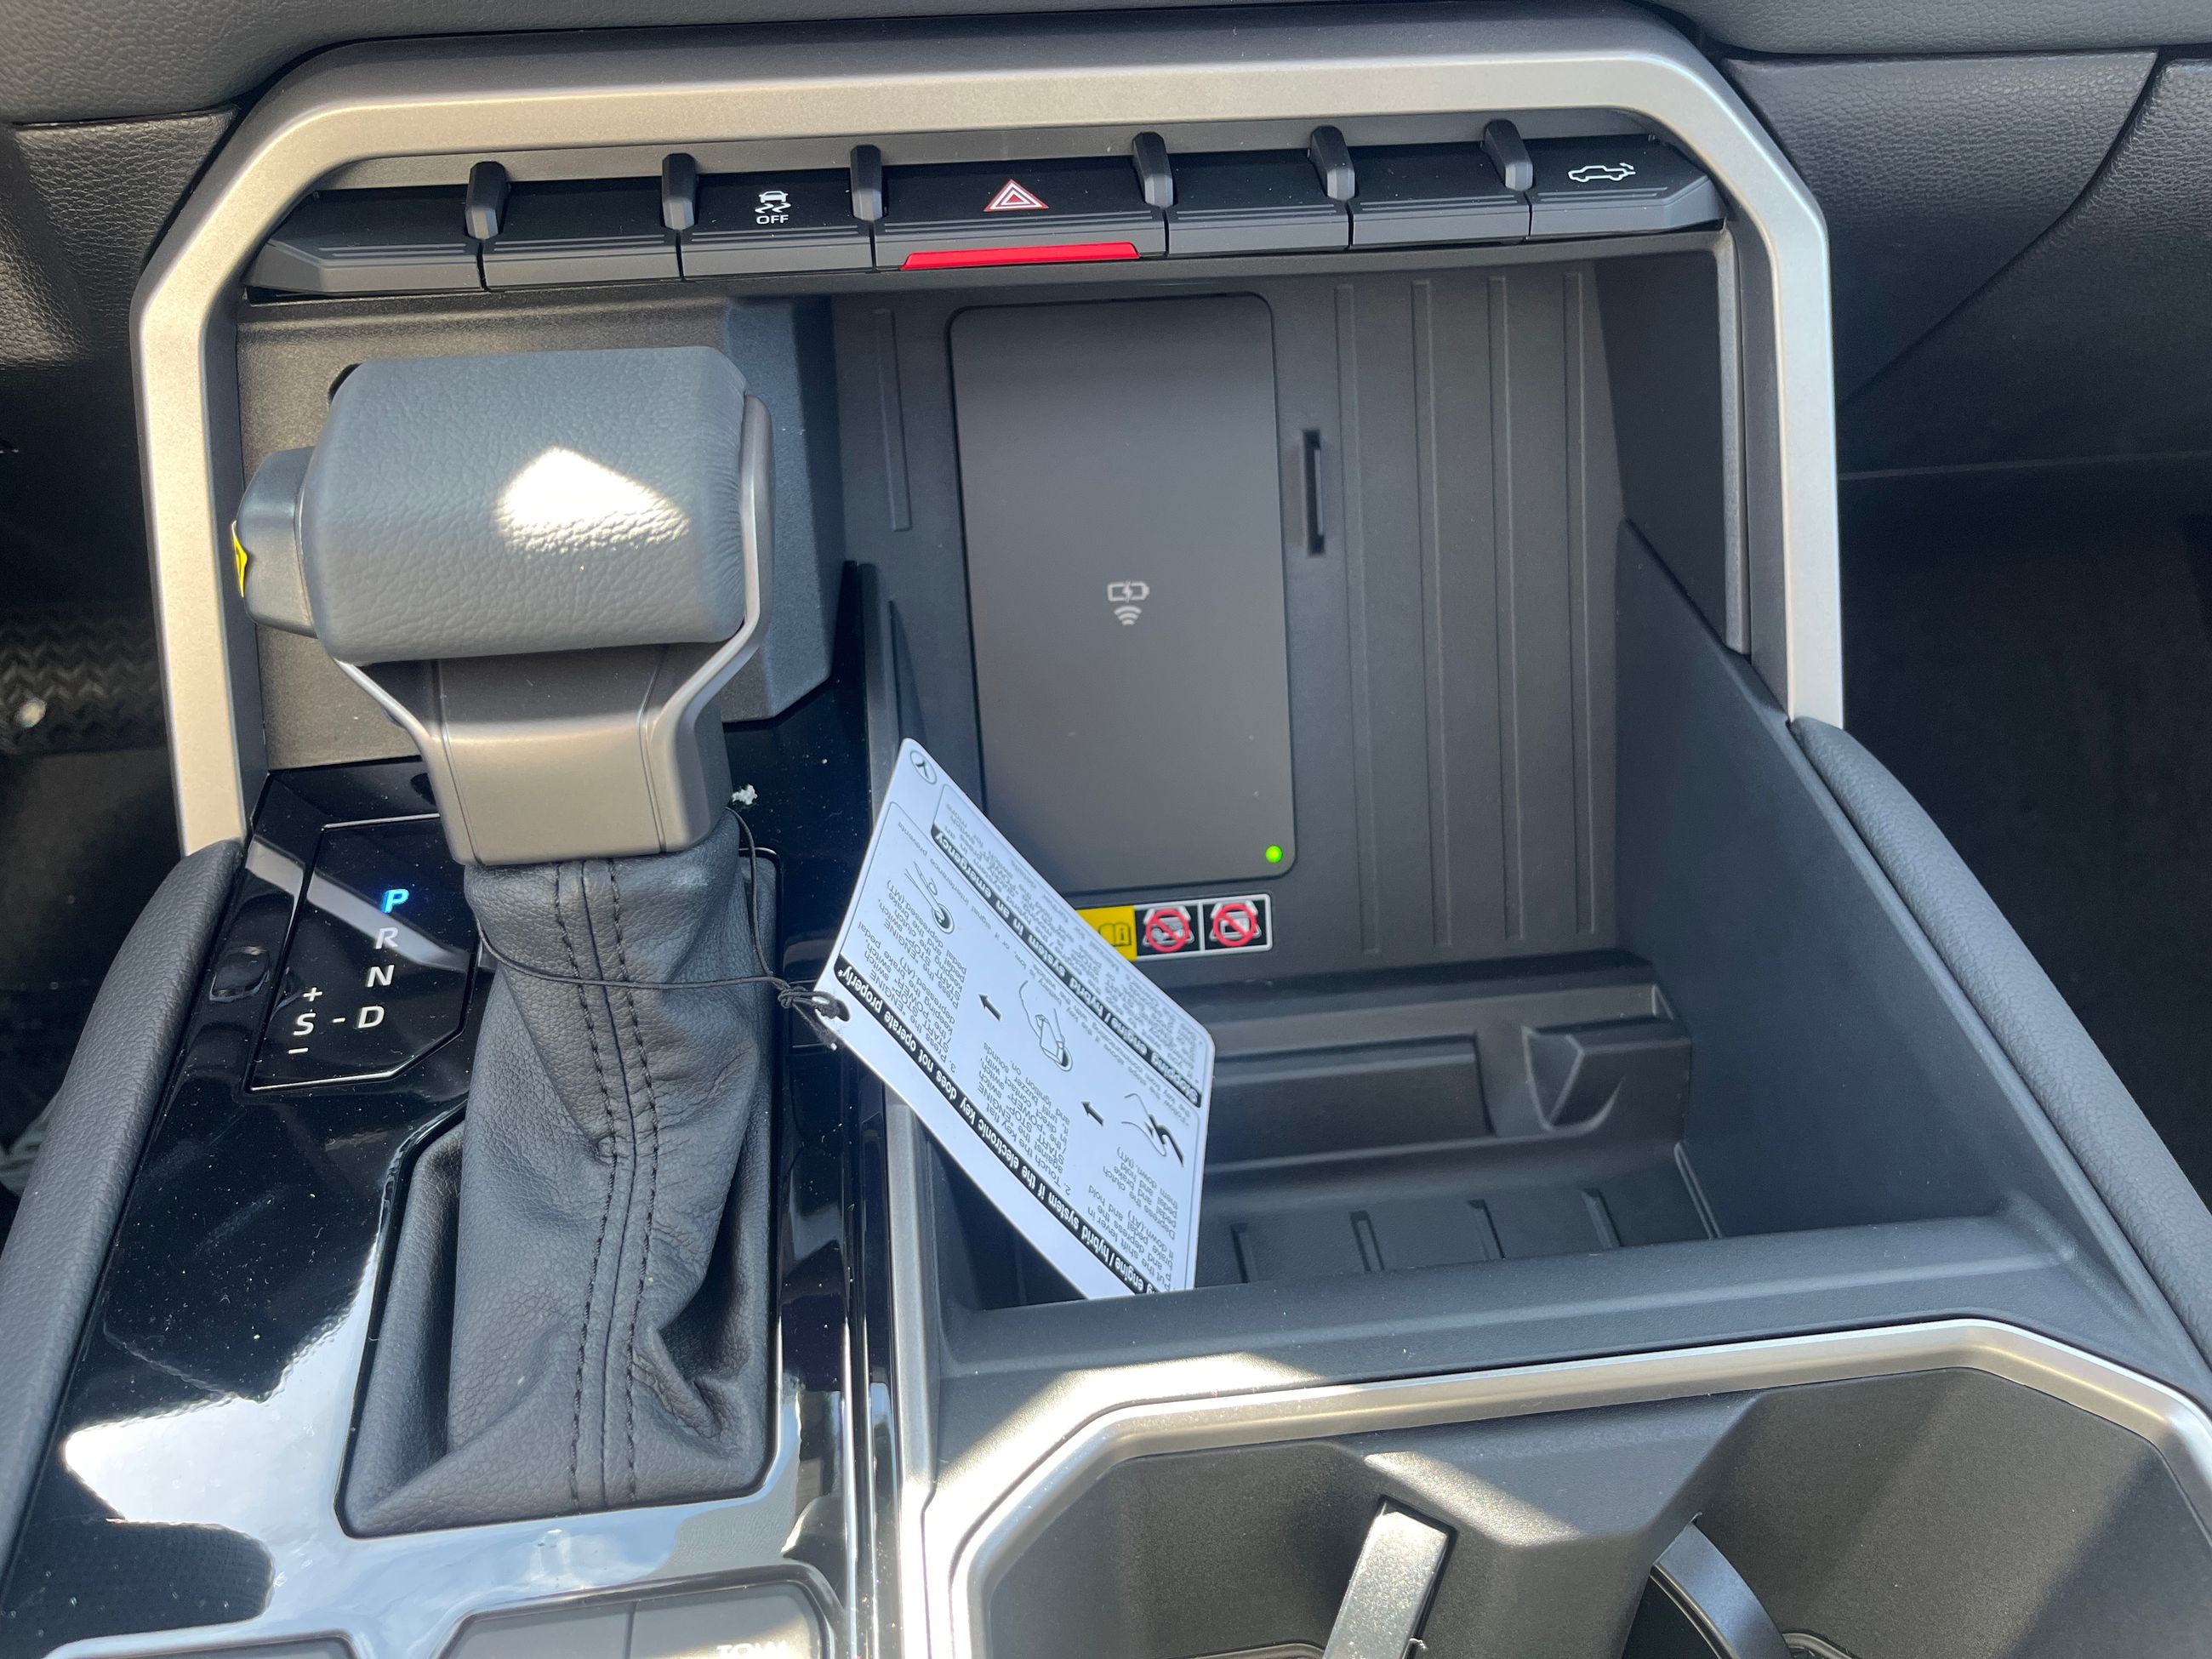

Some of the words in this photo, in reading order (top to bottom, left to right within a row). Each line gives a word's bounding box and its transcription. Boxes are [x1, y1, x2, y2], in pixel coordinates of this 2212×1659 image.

[756, 214, 789, 225] OFF
[897, 820, 927, 857] prevents
[934, 828, 992, 898] emergency
[929, 857, 969, 907] interference
[383, 888, 409, 913] P
[887, 891, 909, 921] brake
[995, 898, 1010, 920] an
[892, 908, 916, 938] clutch
[911, 920, 924, 938] the
[970, 904, 991, 930] signal
[1012, 916, 1024, 938] in
[375, 927, 399, 949] R
[857, 920, 881, 949] pedal
[919, 938, 931, 956] the
[926, 937, 941, 956] and
[863, 949, 889, 982] switch
[864, 938, 892, 974] switch,
[882, 949, 905, 981] brake
[945, 949, 966, 973] pedal
[1027, 932, 1066, 978] system
[367, 965, 395, 987] N
[921, 962, 934, 981] the
[933, 954, 962, 992] keeping
[944, 956, 965, 982] pedal
[908, 978, 921, 999] the
[934, 966, 961, 1001] START
[937, 979, 959, 1010] Press
[293, 1012, 316, 1035] S
[357, 1006, 385, 1029] D
[909, 1014, 922, 1035] the
[923, 995, 953, 1035] keeping
[883, 1009, 917, 1052] operate
[921, 1017, 949, 1053] START
[916, 1047, 934, 1073] not
[924, 1032, 947, 1063] Press
[983, 1041, 1010, 1074] sounds
[949, 1058, 956, 1074] 3.
[979, 1057, 1005, 1090] switch,
[984, 1054, 1001, 1075] with
[1150, 1048, 1198, 1105] Stopping
[935, 1068, 957, 1103] does
[978, 1069, 1002, 1099] switch
[1003, 1075, 1031, 1108] contact
[1013, 1074, 1038, 1105] buzzer
[1024, 1075, 1052, 1109] ignition
[959, 1092, 976, 1126] key
[985, 1102, 1000, 1124] flat
[1035, 1108, 1057, 1135] direct
[1041, 1103, 1058, 1123] until
[1055, 1106, 1069, 1126] and
[1001, 1116, 1017, 1142] key
[1018, 1124, 1030, 1143] the
[1059, 1132, 1067, 1145] in
[977, 1116, 1019, 1170] electronic
[1018, 1137, 1033, 1158] the
[1036, 1132, 1064, 1166] START
[1033, 1140, 1063, 1174] against
[1020, 1163, 1036, 1191] the
[1034, 1154, 1061, 1187] Touch
[1102, 1165, 1126, 1192] clutch
[1113, 1164, 1134, 1190] brake
[1036, 1180, 1046, 1201] if
[1063, 1182, 1071, 1197] 2.
[1087, 1183, 1105, 1206] hold
[1128, 1189, 1142, 1209] the
[1137, 1187, 1152, 1206] and
[1047, 1190, 1080, 1230] system
[1086, 1206, 1095, 1221] in
[1097, 1203, 1110, 1223] the
[1108, 1202, 1123, 1222] and
[1143, 1203, 1175, 1240] Depress
[1155, 1205, 1176, 1229] pedal
[1096, 1215, 1118, 1243] lever
[1113, 1218, 1144, 1257] depress
[1126, 1220, 1149, 1246] pedal
[1120, 1237, 1138, 1260] shift
[1147, 1251, 1162, 1271] and
[1151, 1243, 1172, 1272] brake
[1141, 1257, 1154, 1277] the
[1165, 1268, 1171, 1282] P
[1155, 1271, 1170, 1292] Put
